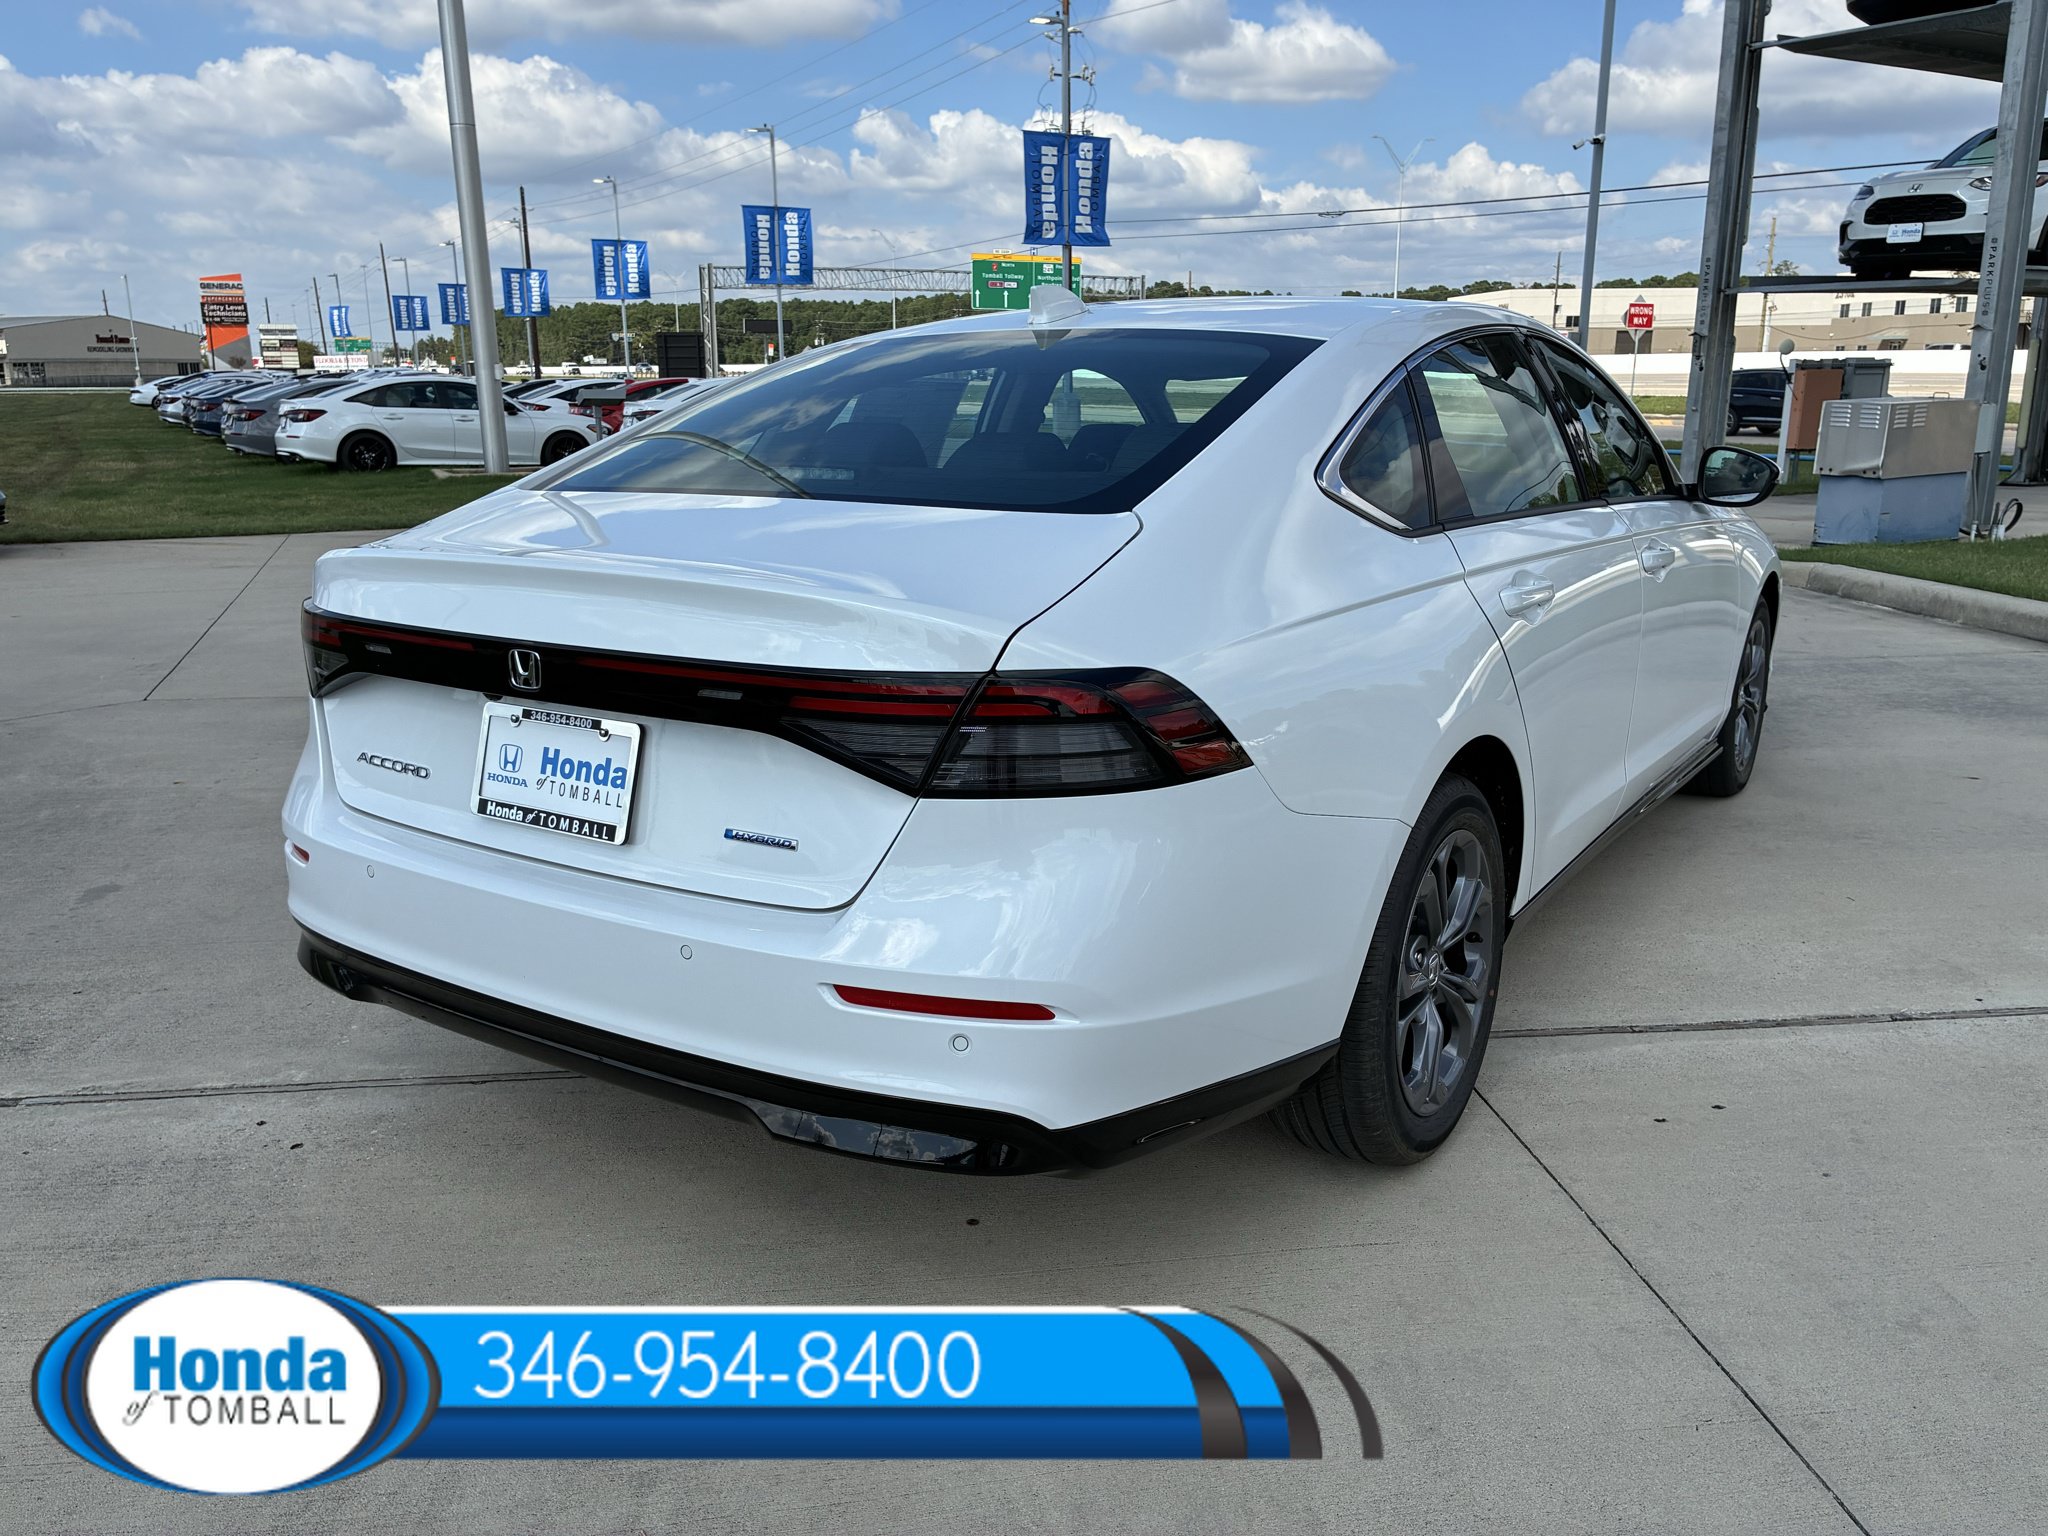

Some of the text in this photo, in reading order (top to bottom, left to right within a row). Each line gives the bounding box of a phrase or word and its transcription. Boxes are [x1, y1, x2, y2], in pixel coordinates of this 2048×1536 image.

[1041, 146, 1058, 239] Honda
[1075, 142, 1093, 233] Honda
[756, 214, 772, 279] Honda
[784, 212, 800, 276] Honda
[603, 246, 617, 296] Honda
[625, 244, 640, 293] Honda
[446, 288, 457, 322] Honda
[510, 273, 522, 314] Honda
[529, 272, 541, 312] Honda
[1631, 307, 1652, 315] WRONG
[1633, 317, 1648, 325] WAY
[530, 710, 592, 729] 346-954-8400
[356, 751, 431, 779] ACCORD
[487, 772, 528, 788] HONDA
[540, 746, 627, 790] Honda
[536, 776, 623, 808] of TOMBALL
[486, 801, 609, 840] Honda of TOMBALL
[734, 831, 793, 848] HYBRID
